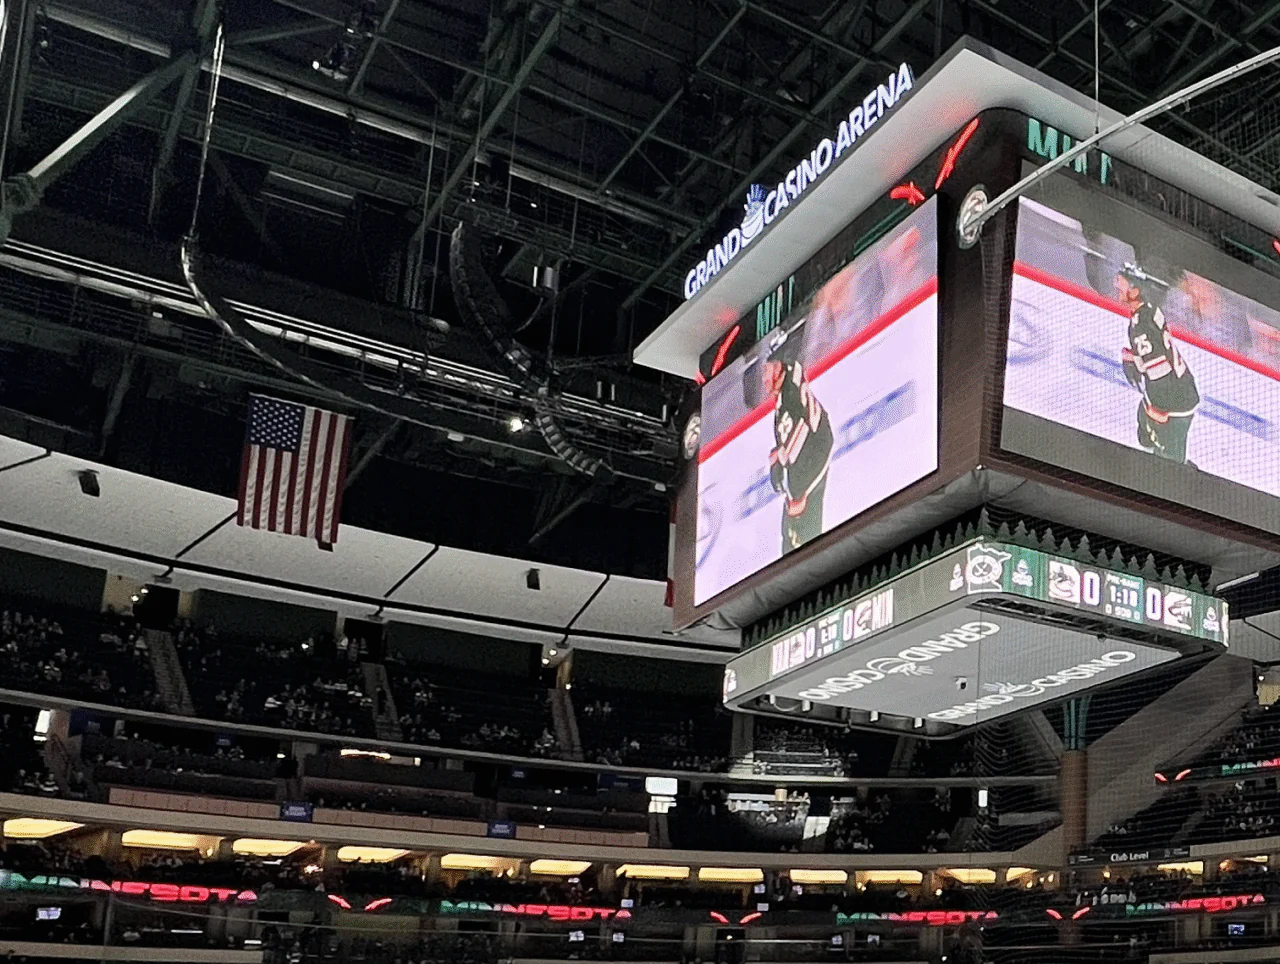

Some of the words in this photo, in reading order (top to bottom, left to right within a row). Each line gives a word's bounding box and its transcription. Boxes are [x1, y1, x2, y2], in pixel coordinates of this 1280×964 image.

[684, 227, 742, 300] GRAND
[764, 138, 833, 225] CASINO
[835, 62, 913, 158] ARENA
[1084, 571, 1101, 606] 0
[1146, 587, 1162, 621] 0
[928, 693, 1014, 721] GRAND
[1032, 650, 1136, 688] CASINO
[1110, 853, 1128, 862] Club
[1129, 851, 1149, 861] Level
